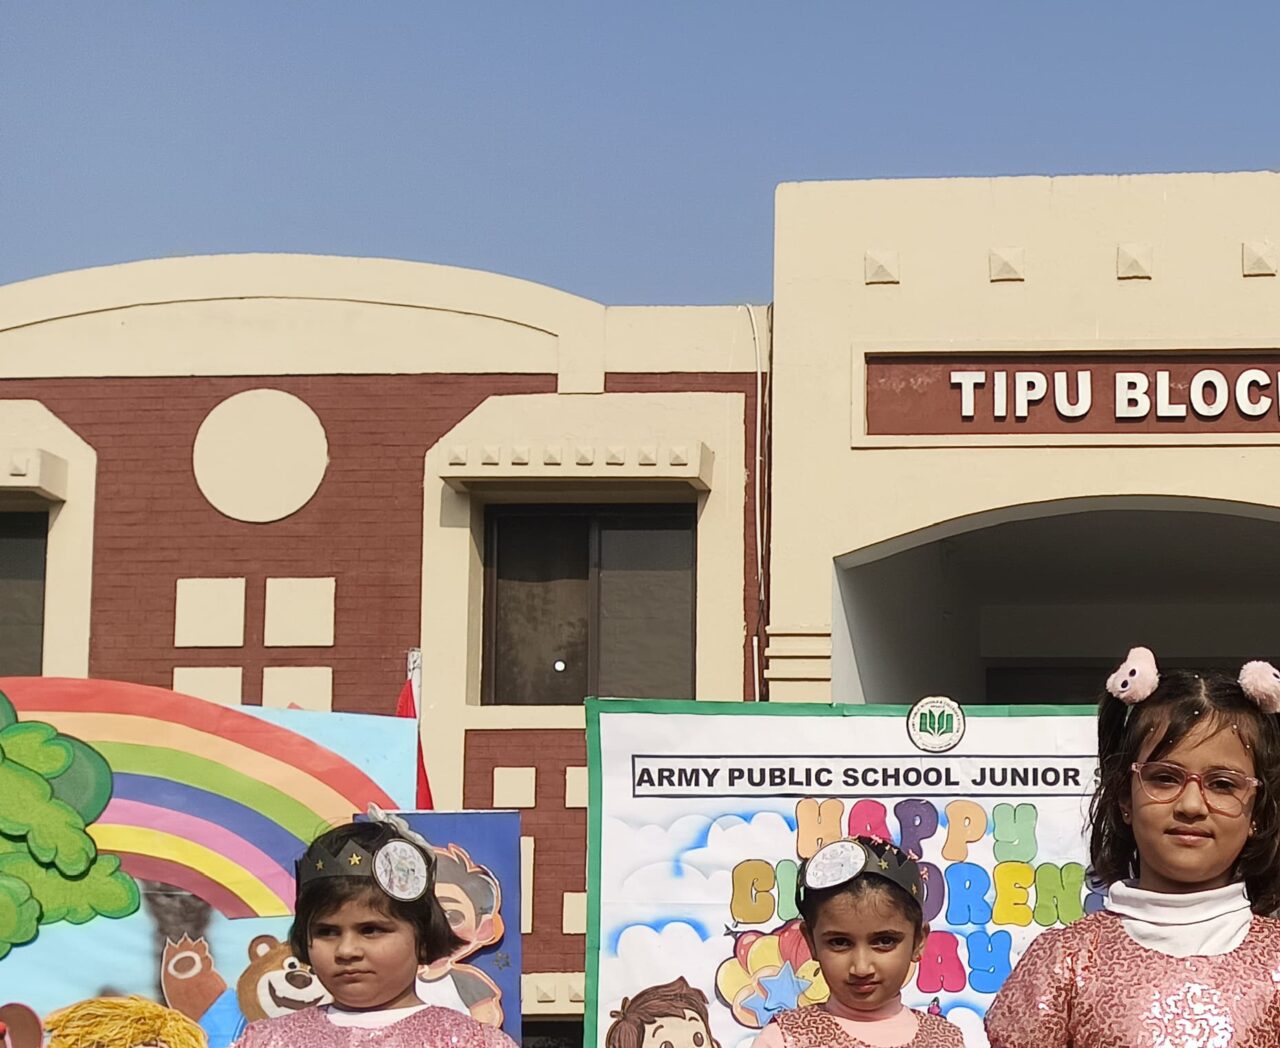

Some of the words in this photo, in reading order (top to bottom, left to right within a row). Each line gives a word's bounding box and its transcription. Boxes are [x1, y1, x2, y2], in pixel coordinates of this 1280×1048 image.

[950, 370, 1093, 418] TIPU
[636, 767, 720, 787] ARMY
[728, 767, 833, 787] PUBLIC
[842, 767, 960, 787] SCHOOL
[971, 767, 1081, 787] JUNIOR
[795, 797, 1039, 863] HAPPY
[901, 929, 1013, 994] AY
